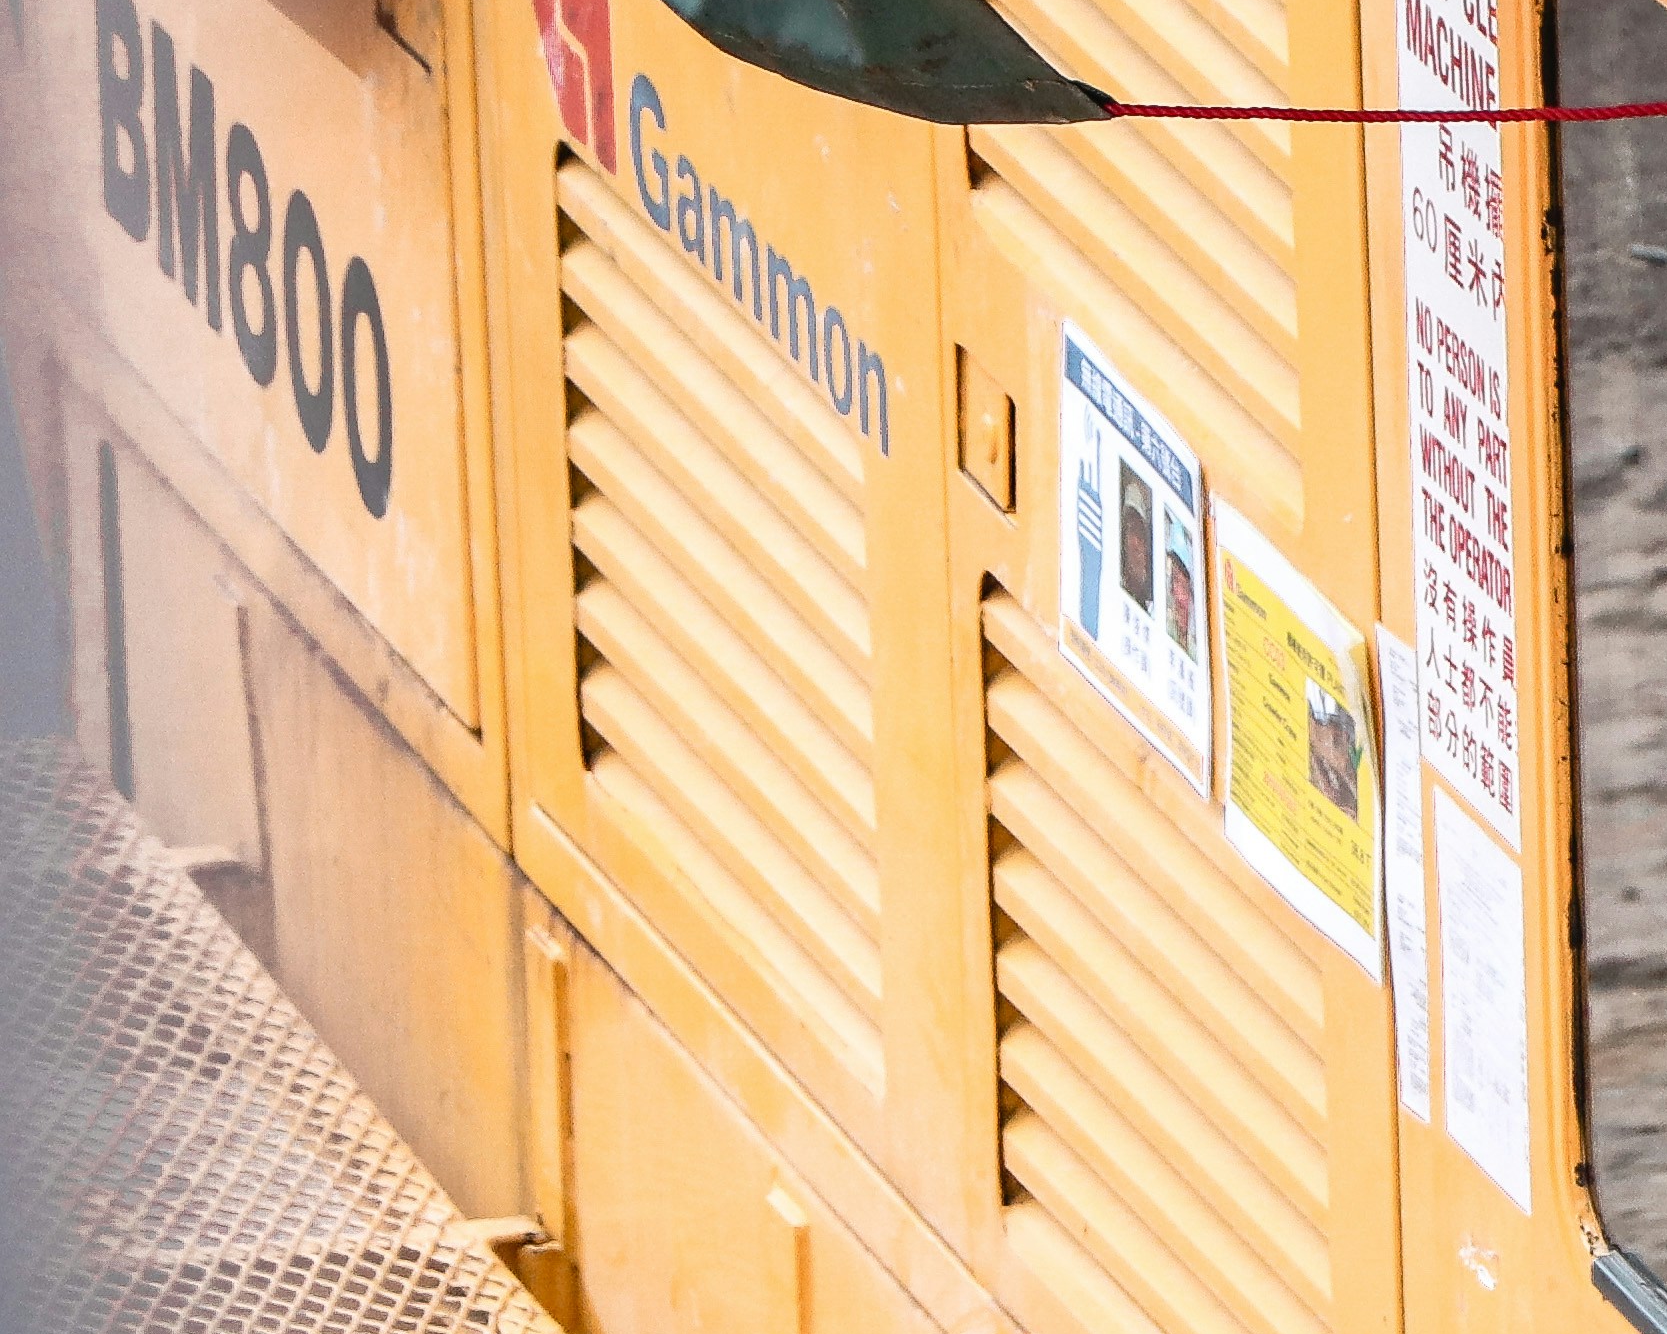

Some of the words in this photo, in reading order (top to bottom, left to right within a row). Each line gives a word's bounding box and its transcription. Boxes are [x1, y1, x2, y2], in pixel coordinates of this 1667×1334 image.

[628, 74, 892, 458] Gammon
[1414, 295, 1434, 357] NO
[1436, 315, 1486, 407] PERSON
[1488, 364, 1502, 422] IS
[1416, 358, 1434, 419] TO
[1443, 384, 1468, 450] ANY
[1477, 416, 1508, 490] PART
[1418, 422, 1476, 522] WITHOUT
[1484, 484, 1510, 553] THE
[1420, 485, 1447, 554] THE
[1449, 513, 1514, 619] OPERATOR
[1425, 626, 1514, 753] 人士都不能
[1426, 687, 1514, 816] 部分的範圍
